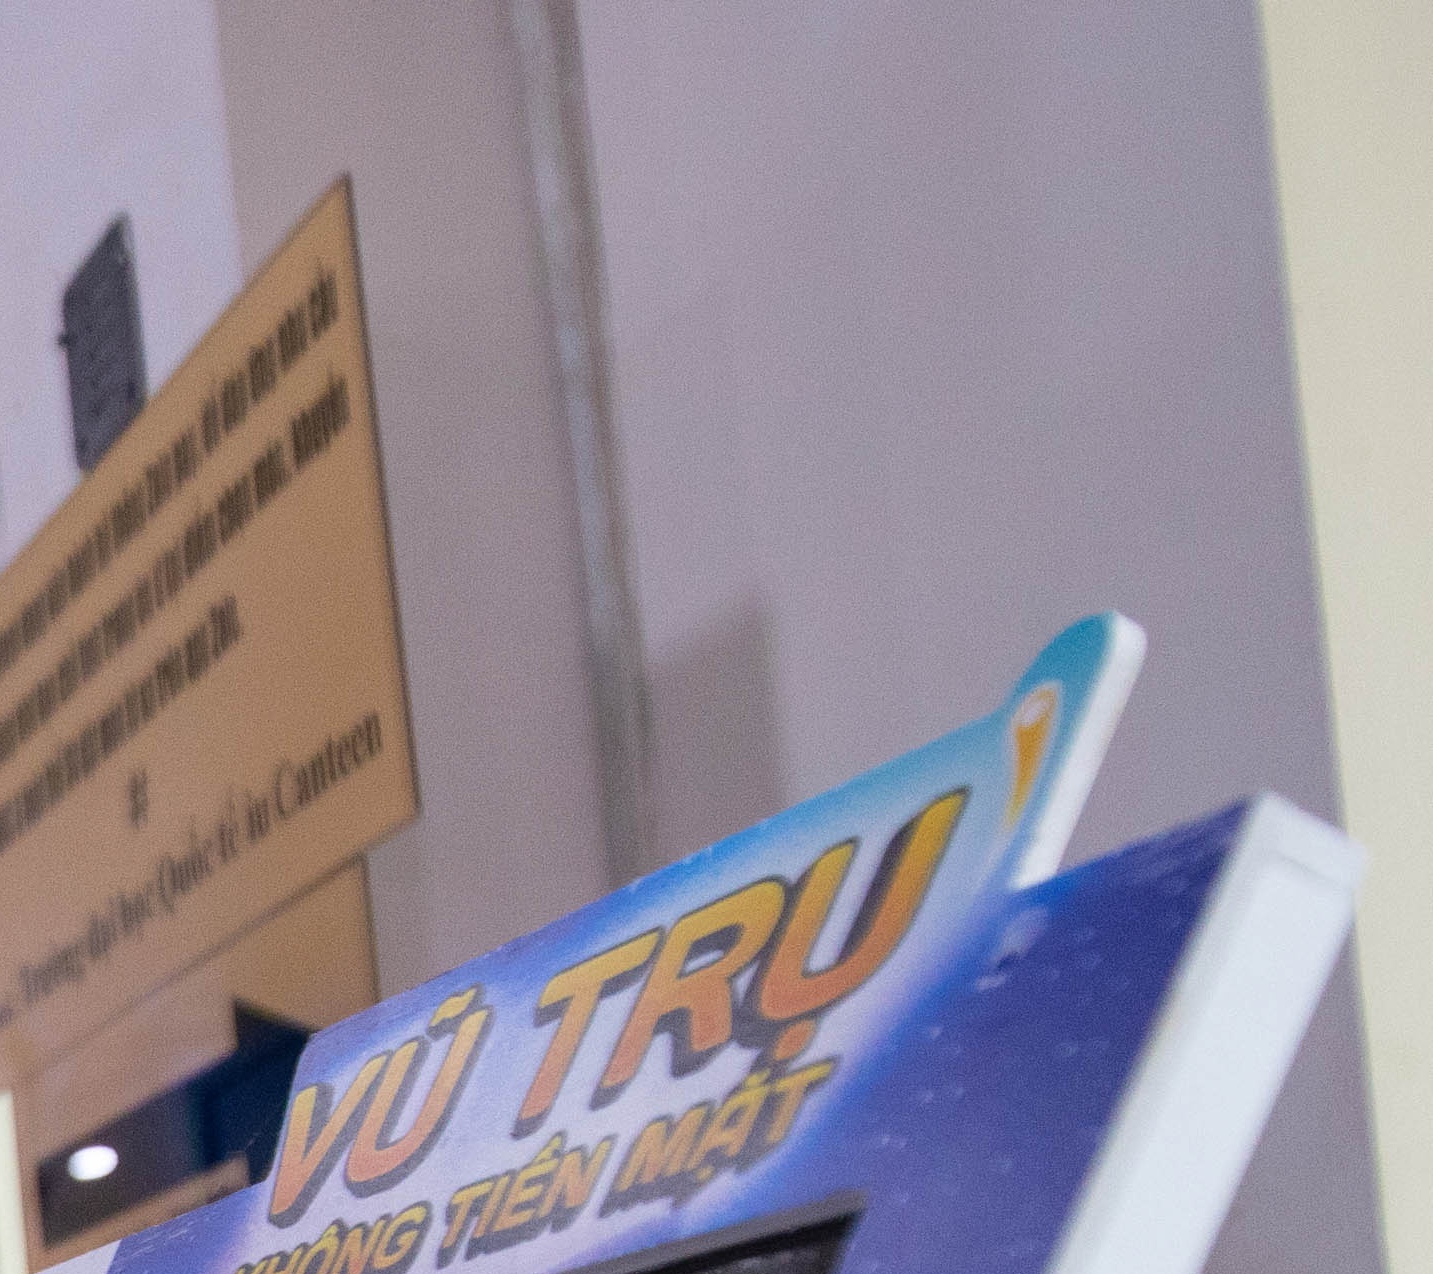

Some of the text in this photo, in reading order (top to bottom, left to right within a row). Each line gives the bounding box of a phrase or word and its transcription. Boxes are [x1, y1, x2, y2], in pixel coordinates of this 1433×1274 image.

[275, 712, 383, 822] Canteen
[266, 787, 972, 1228] VŨ TRỤ
[438, 1131, 614, 1268] TIỀN
